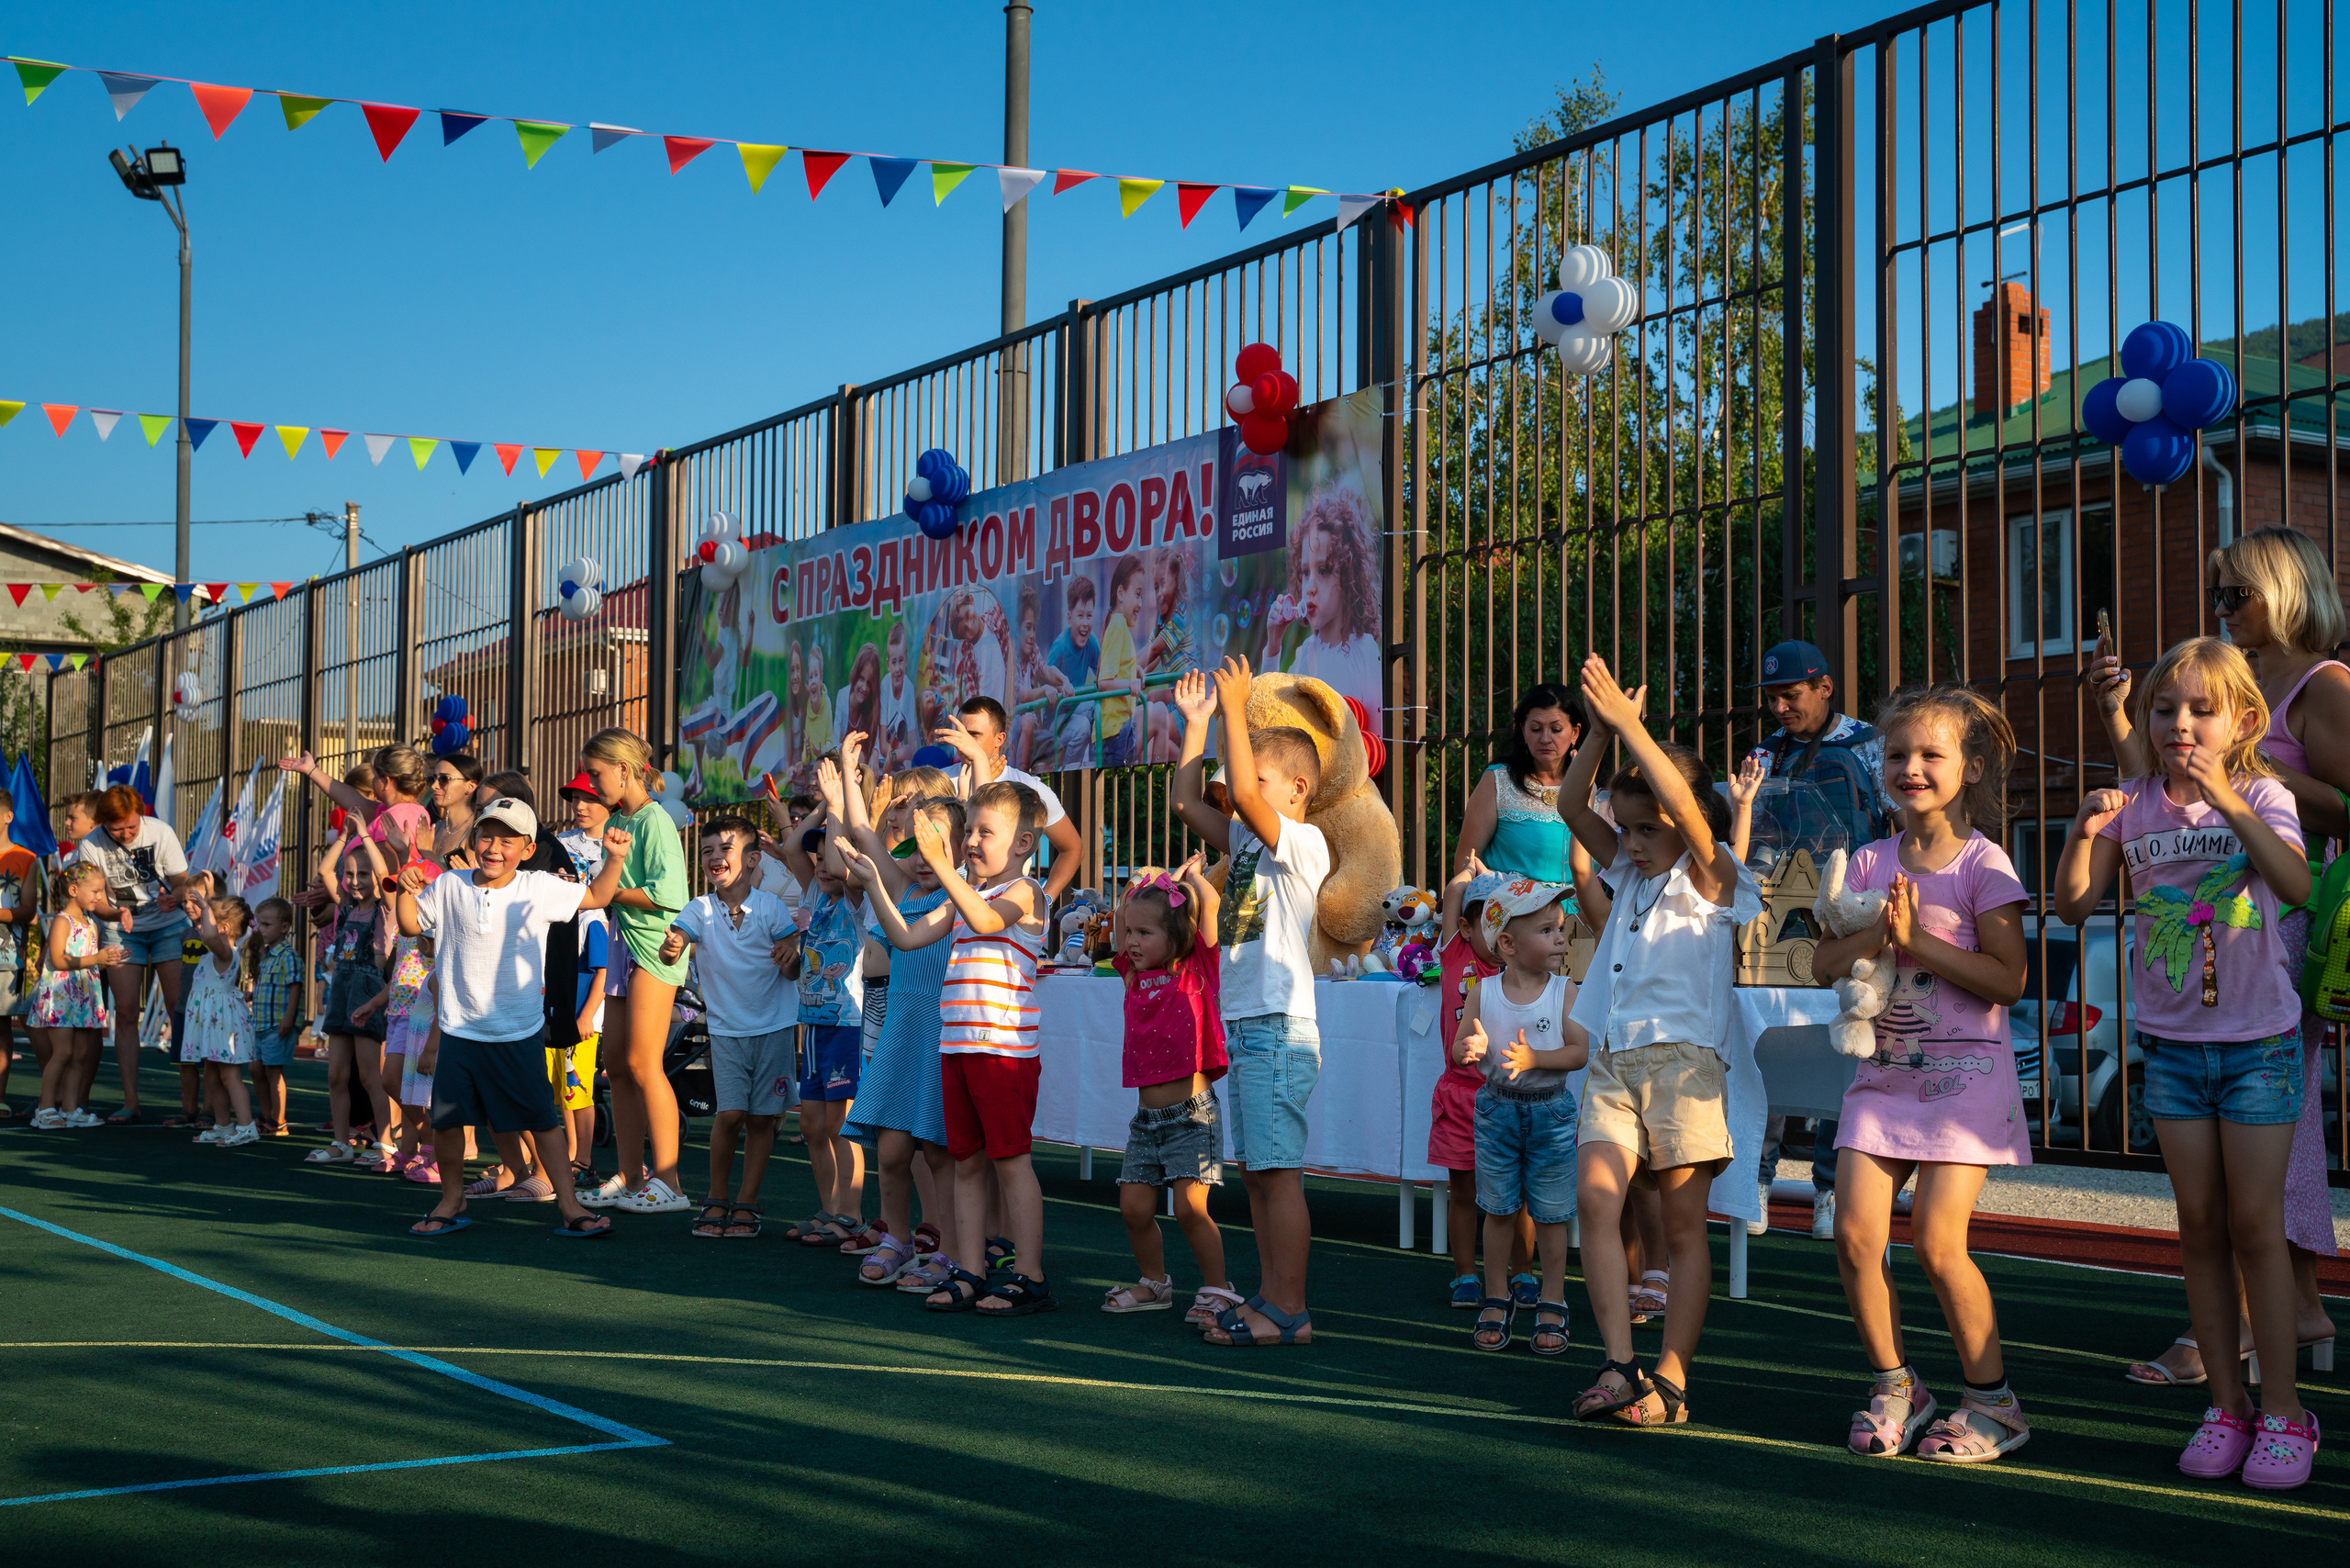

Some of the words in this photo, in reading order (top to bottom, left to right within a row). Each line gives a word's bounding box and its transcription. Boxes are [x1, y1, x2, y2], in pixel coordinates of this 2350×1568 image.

[1232, 506, 1274, 527] ЕДИНАЯ
[1232, 521, 1273, 542] РОССИЯ
[771, 566, 790, 624] С
[796, 506, 1036, 617] ПРАЗДНИКОМ
[1046, 462, 1215, 581] ДВОРА!
[2125, 839, 2167, 868] ELO,
[1153, 975, 1172, 987] VIBE
[1946, 1025, 1963, 1036] LOL
[1496, 1087, 1554, 1103] FRIENDSHIP
[1924, 1074, 1966, 1098] LOL
